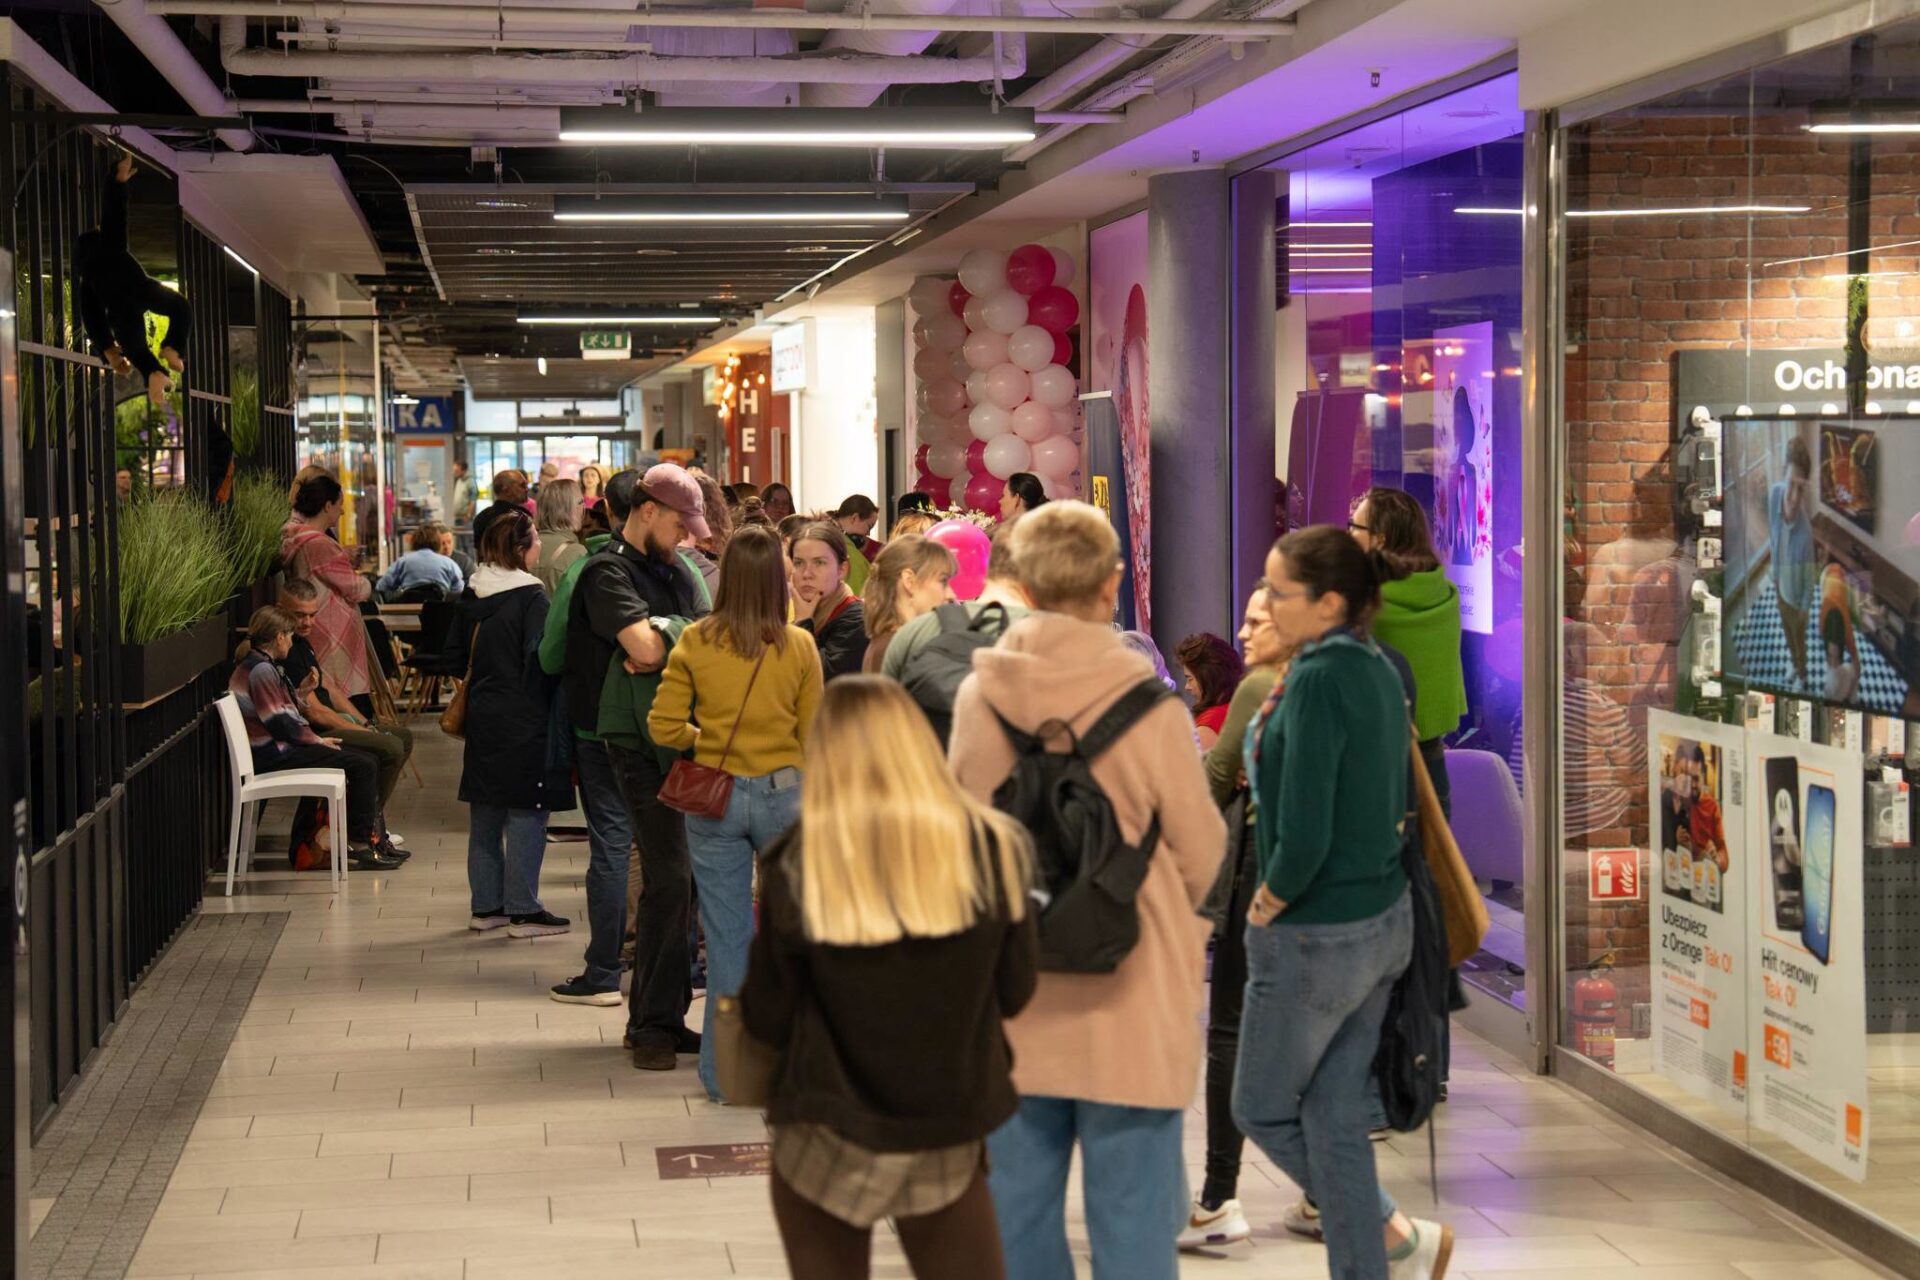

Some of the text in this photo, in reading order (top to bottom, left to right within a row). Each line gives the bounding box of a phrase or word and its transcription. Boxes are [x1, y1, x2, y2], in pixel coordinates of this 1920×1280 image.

[1774, 360, 1920, 391] Ochona
[1662, 904, 1708, 939] Ubezpiecz
[1661, 934, 1668, 949] z
[1669, 932, 1703, 965] Orange
[1704, 945, 1722, 969] Tak
[1761, 947, 1819, 995] Hit cenowy
[1763, 974, 1782, 1001] Tak
